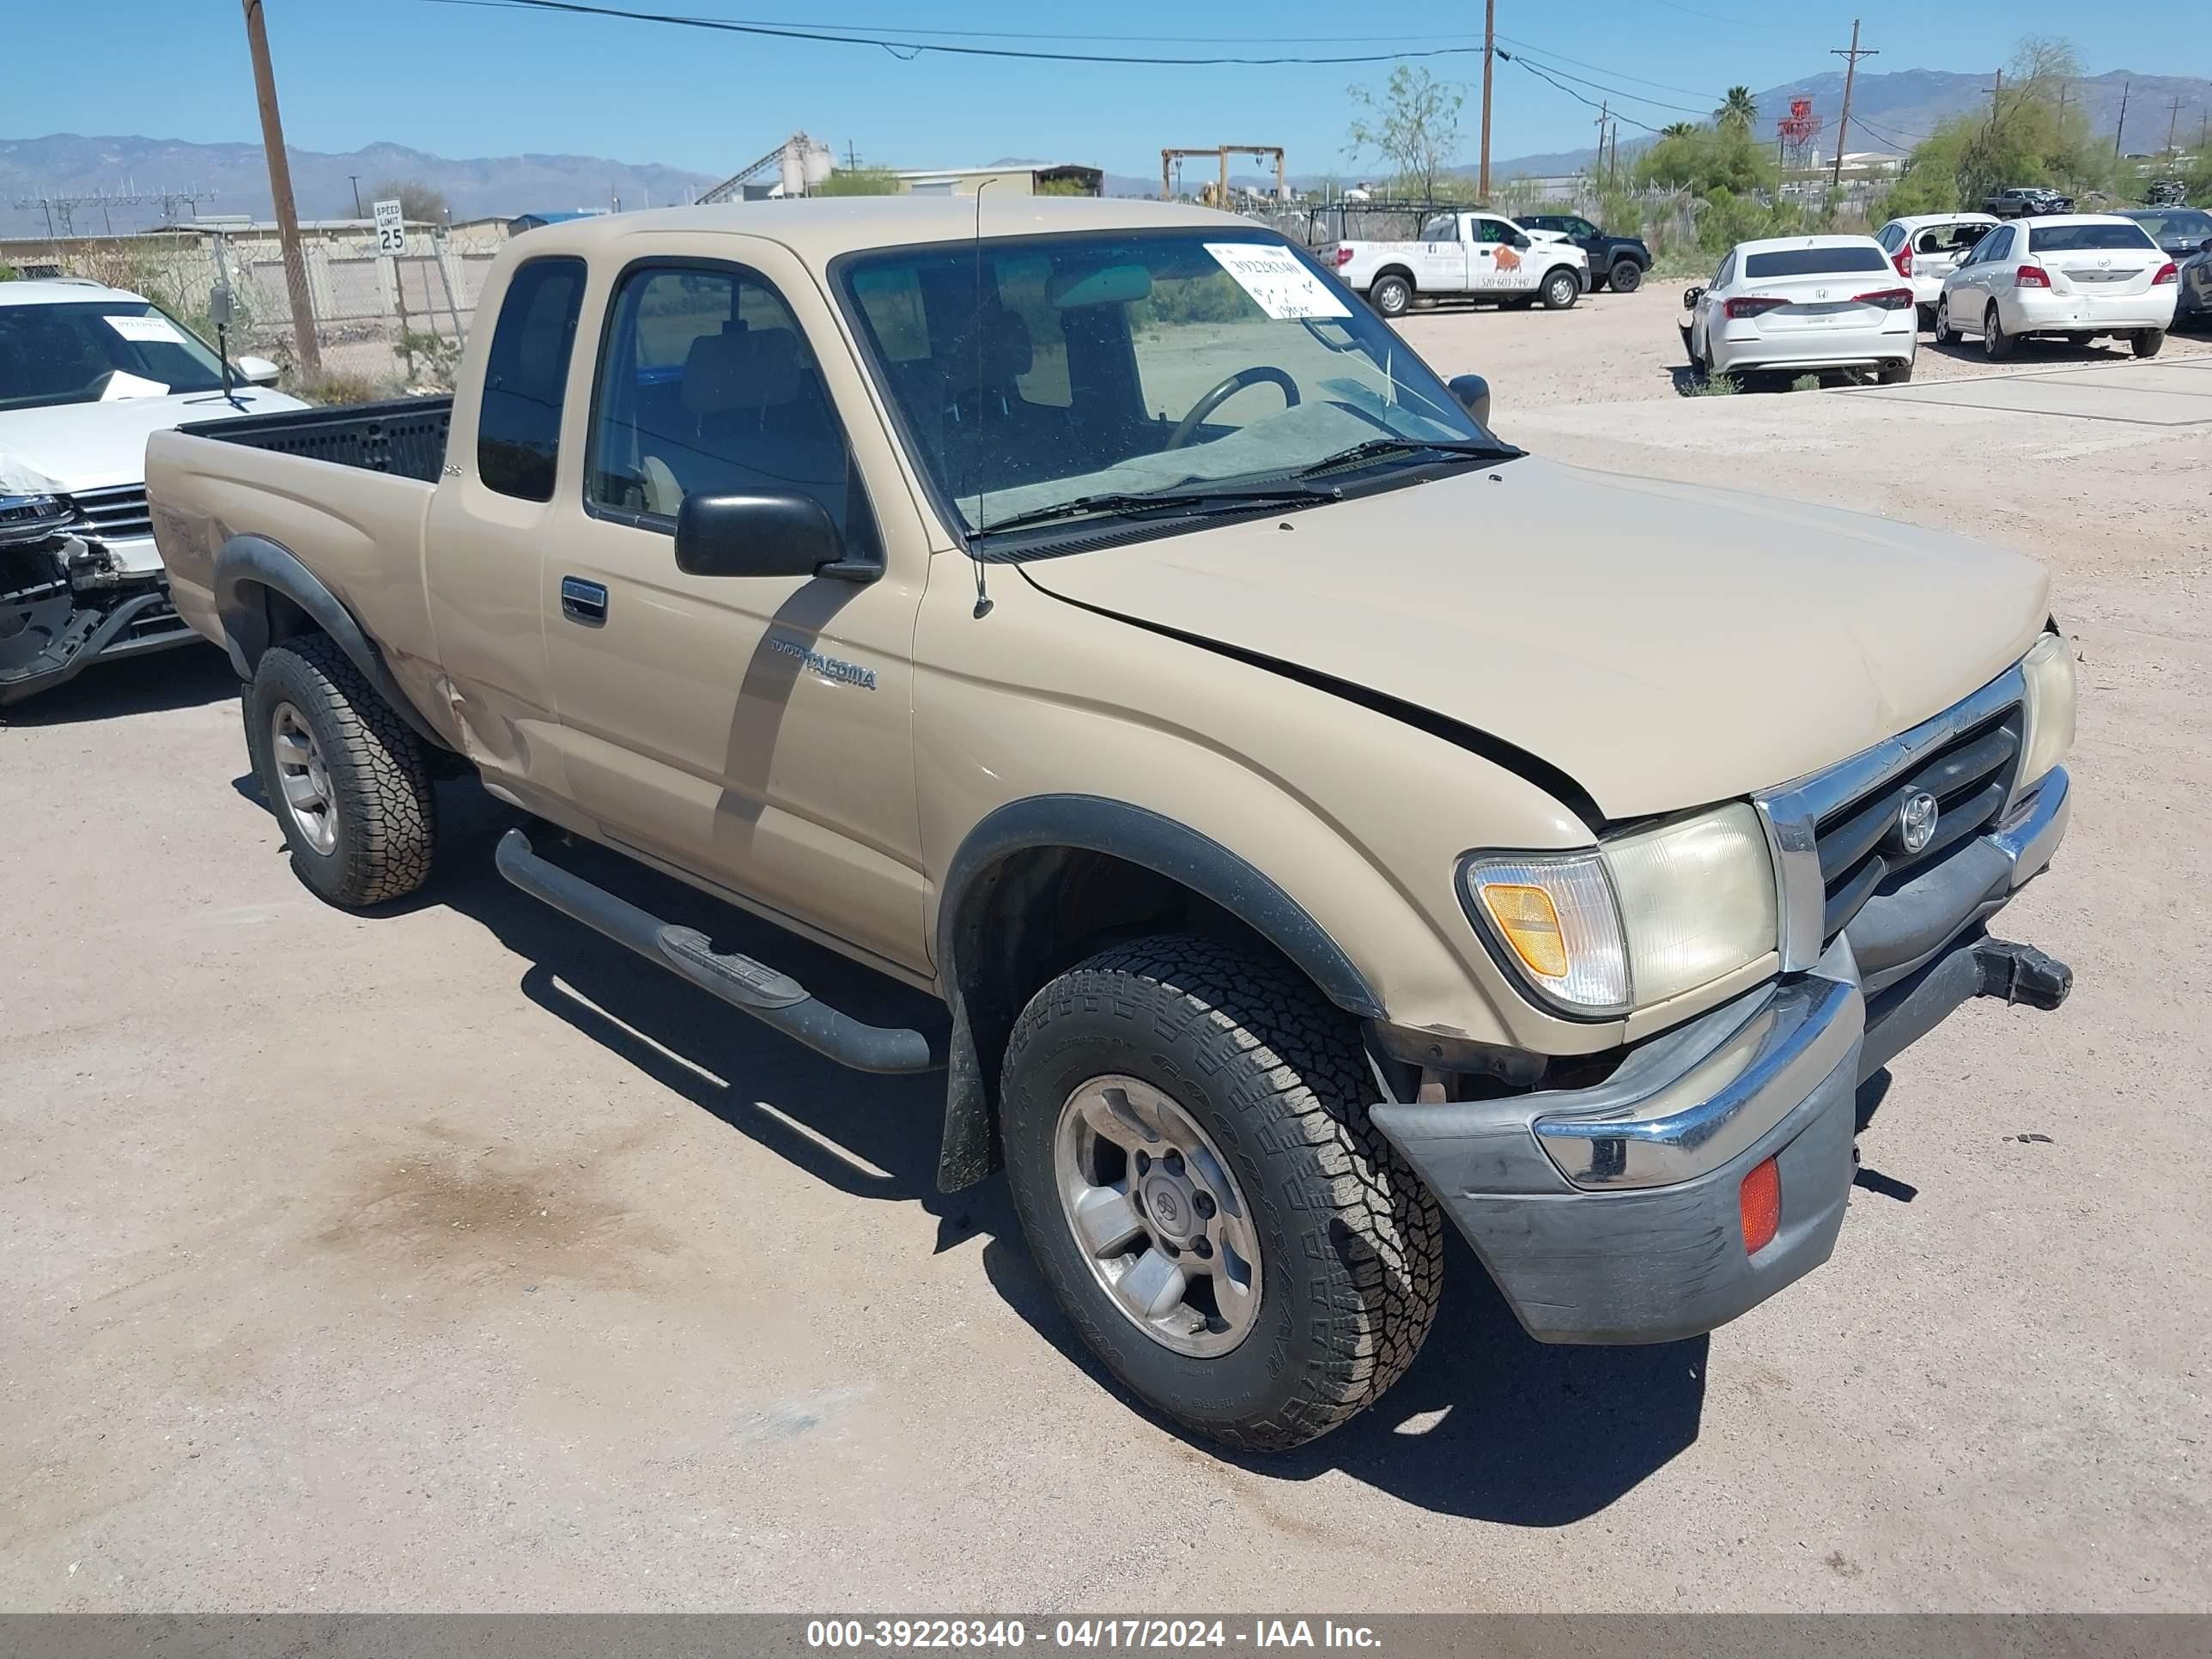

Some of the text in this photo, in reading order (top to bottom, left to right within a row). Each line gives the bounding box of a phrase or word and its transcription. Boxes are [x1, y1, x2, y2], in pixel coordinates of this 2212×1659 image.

[376, 206, 399, 216] SPEED
[380, 216, 398, 227] LIMIT
[380, 228, 404, 250] 25
[1232, 260, 1301, 275] 39228340
[805, 651, 877, 690] TACOMA
[1150, 1053, 1297, 1380] GOODYEAR
